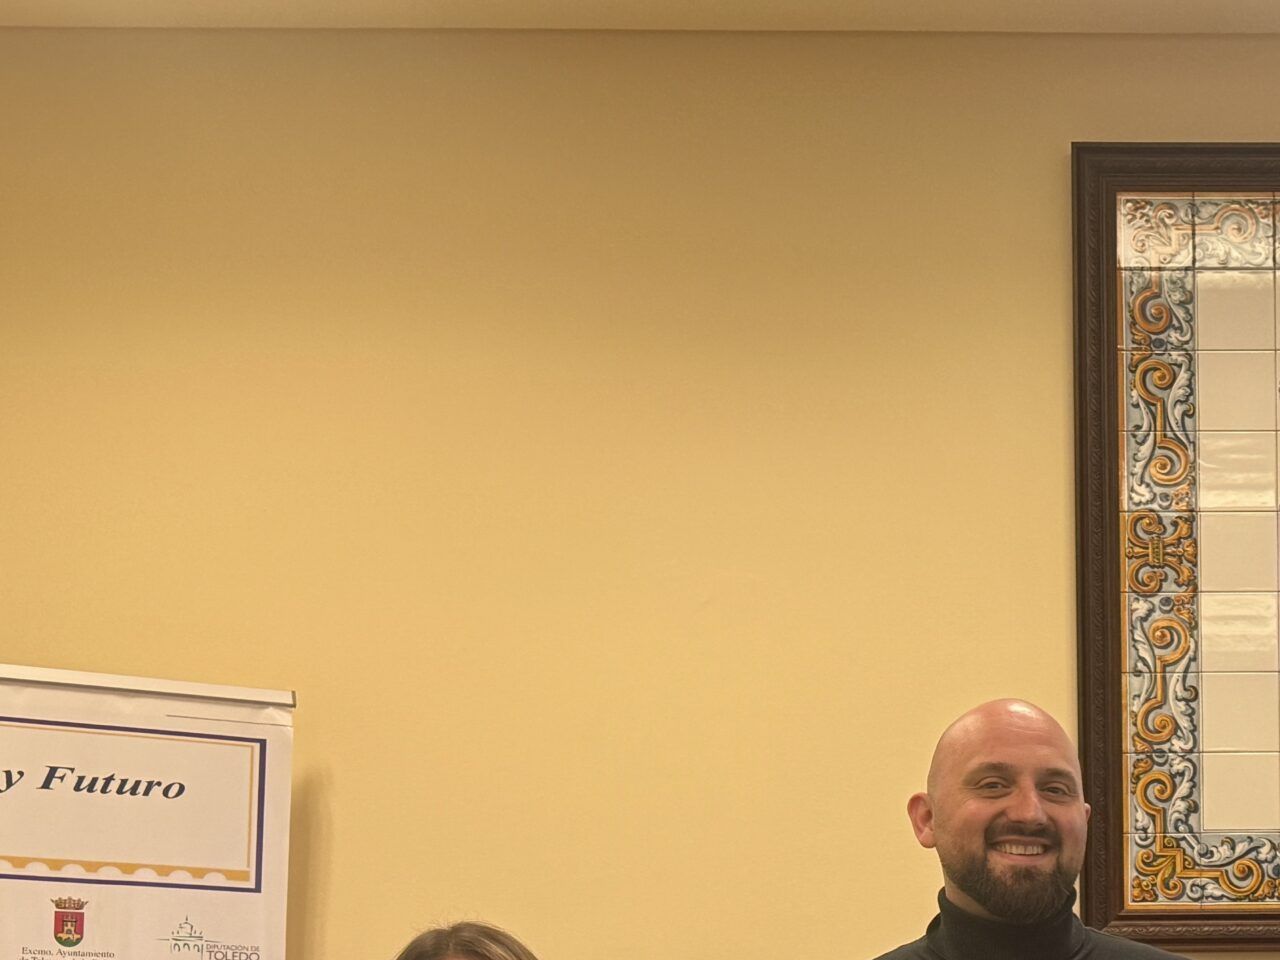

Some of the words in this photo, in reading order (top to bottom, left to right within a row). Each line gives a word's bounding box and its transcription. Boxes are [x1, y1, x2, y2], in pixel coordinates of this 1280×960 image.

[0, 769, 24, 793] y
[36, 766, 186, 799] Futuro
[56, 948, 115, 960] Ayuntamiento
